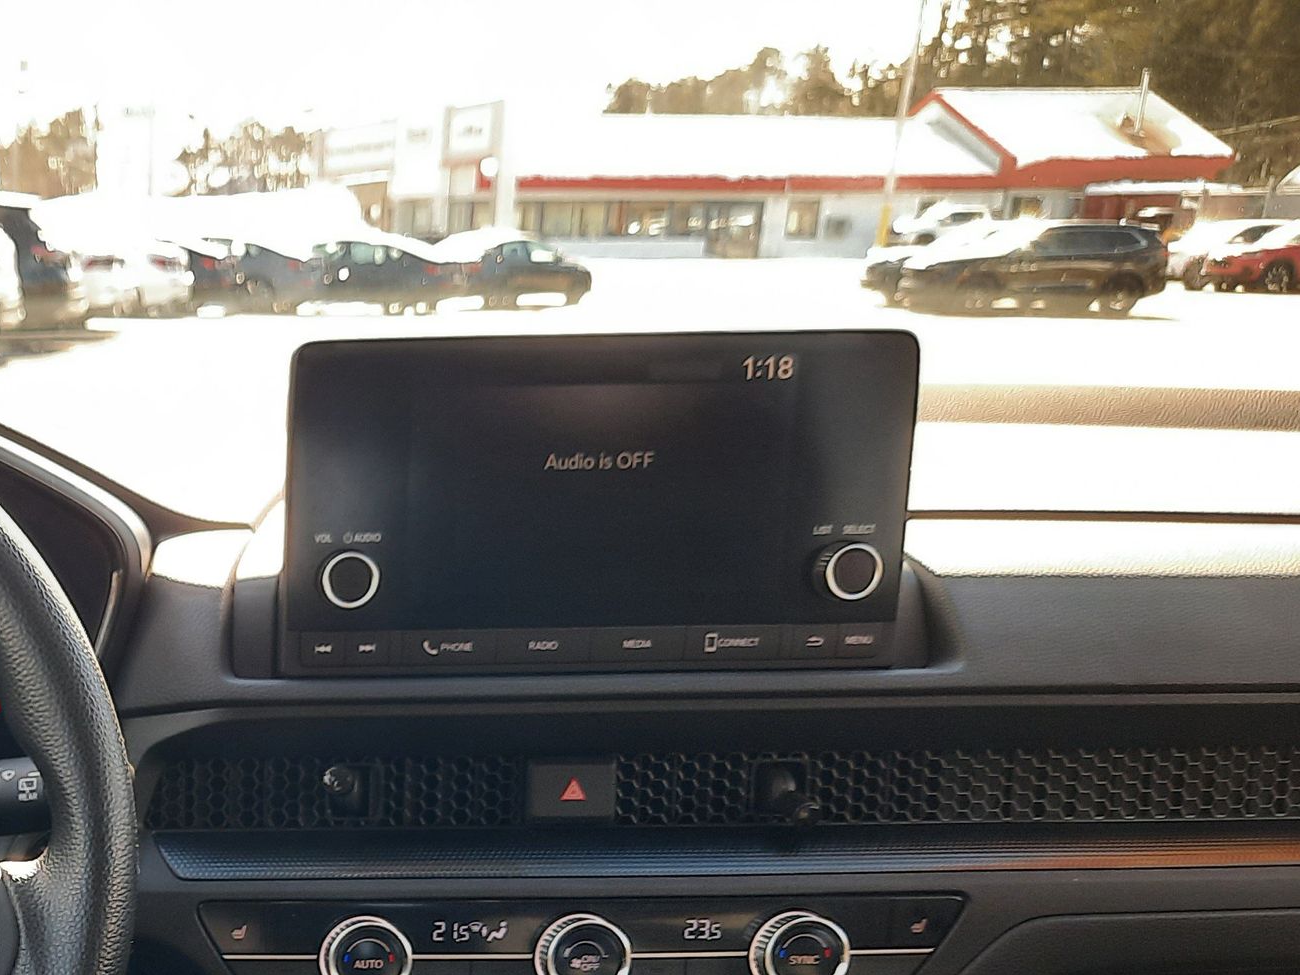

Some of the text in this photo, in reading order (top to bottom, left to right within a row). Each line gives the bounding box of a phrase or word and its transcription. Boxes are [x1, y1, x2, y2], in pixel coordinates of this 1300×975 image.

[742, 355, 795, 380] 1:18
[544, 451, 655, 470] Audio is OFF
[314, 532, 382, 544] VOL AUDIO
[528, 640, 559, 651] RADIO
[622, 638, 652, 649] MEDIA
[717, 636, 761, 648] CONNECT
[844, 635, 874, 646] MENU
[353, 959, 384, 970] AUTO
[788, 954, 821, 966] SYNC
